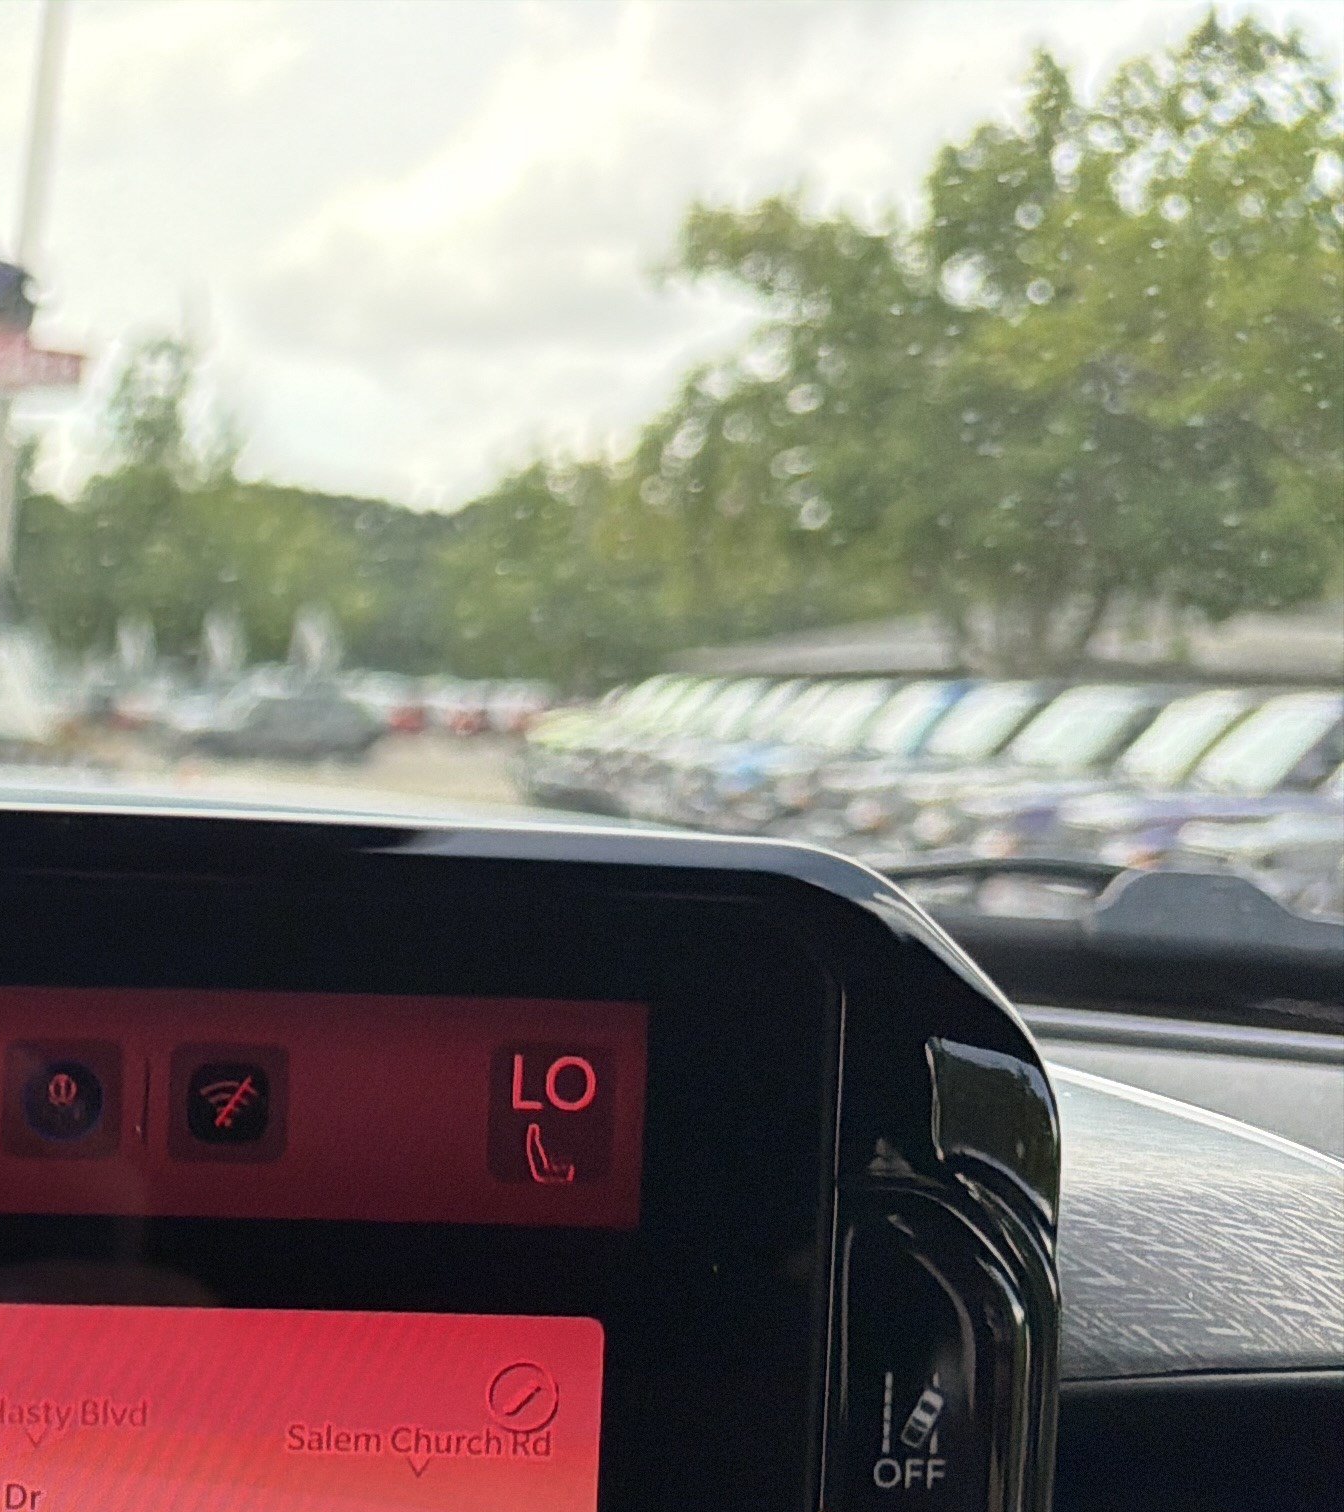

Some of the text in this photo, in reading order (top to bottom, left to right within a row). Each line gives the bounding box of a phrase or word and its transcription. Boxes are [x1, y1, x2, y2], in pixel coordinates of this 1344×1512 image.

[511, 1055, 596, 1112] LO
[80, 1399, 149, 1427] Blvd
[287, 1424, 552, 1457] Salem Church Rd
[873, 1458, 946, 1488] OFF
[5, 1484, 43, 1511] Dr
